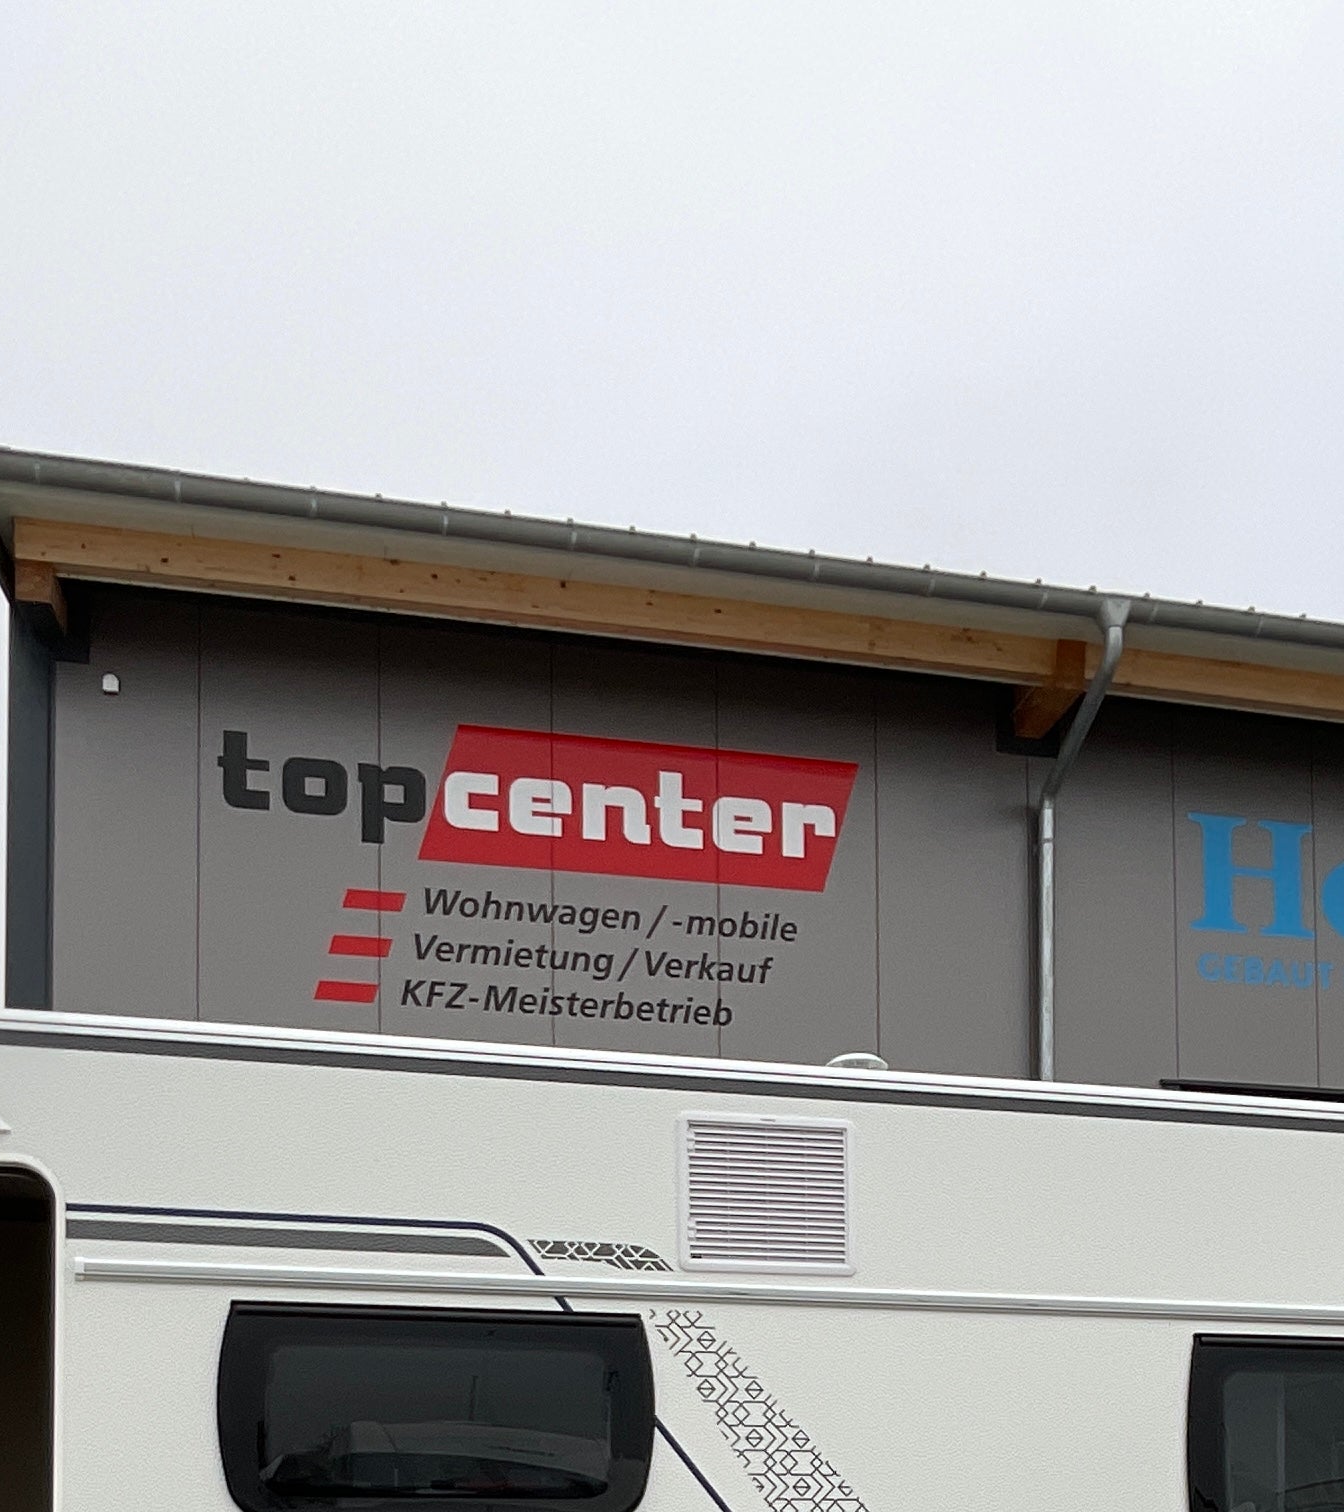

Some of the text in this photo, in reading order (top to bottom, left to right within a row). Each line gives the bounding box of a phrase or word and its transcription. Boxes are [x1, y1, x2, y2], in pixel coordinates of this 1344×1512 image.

[422, 887, 641, 935] Wohnwagen
[1196, 952, 1334, 991] GEBAUT
[399, 979, 734, 1028] KFZ-Meisterbetrieb
